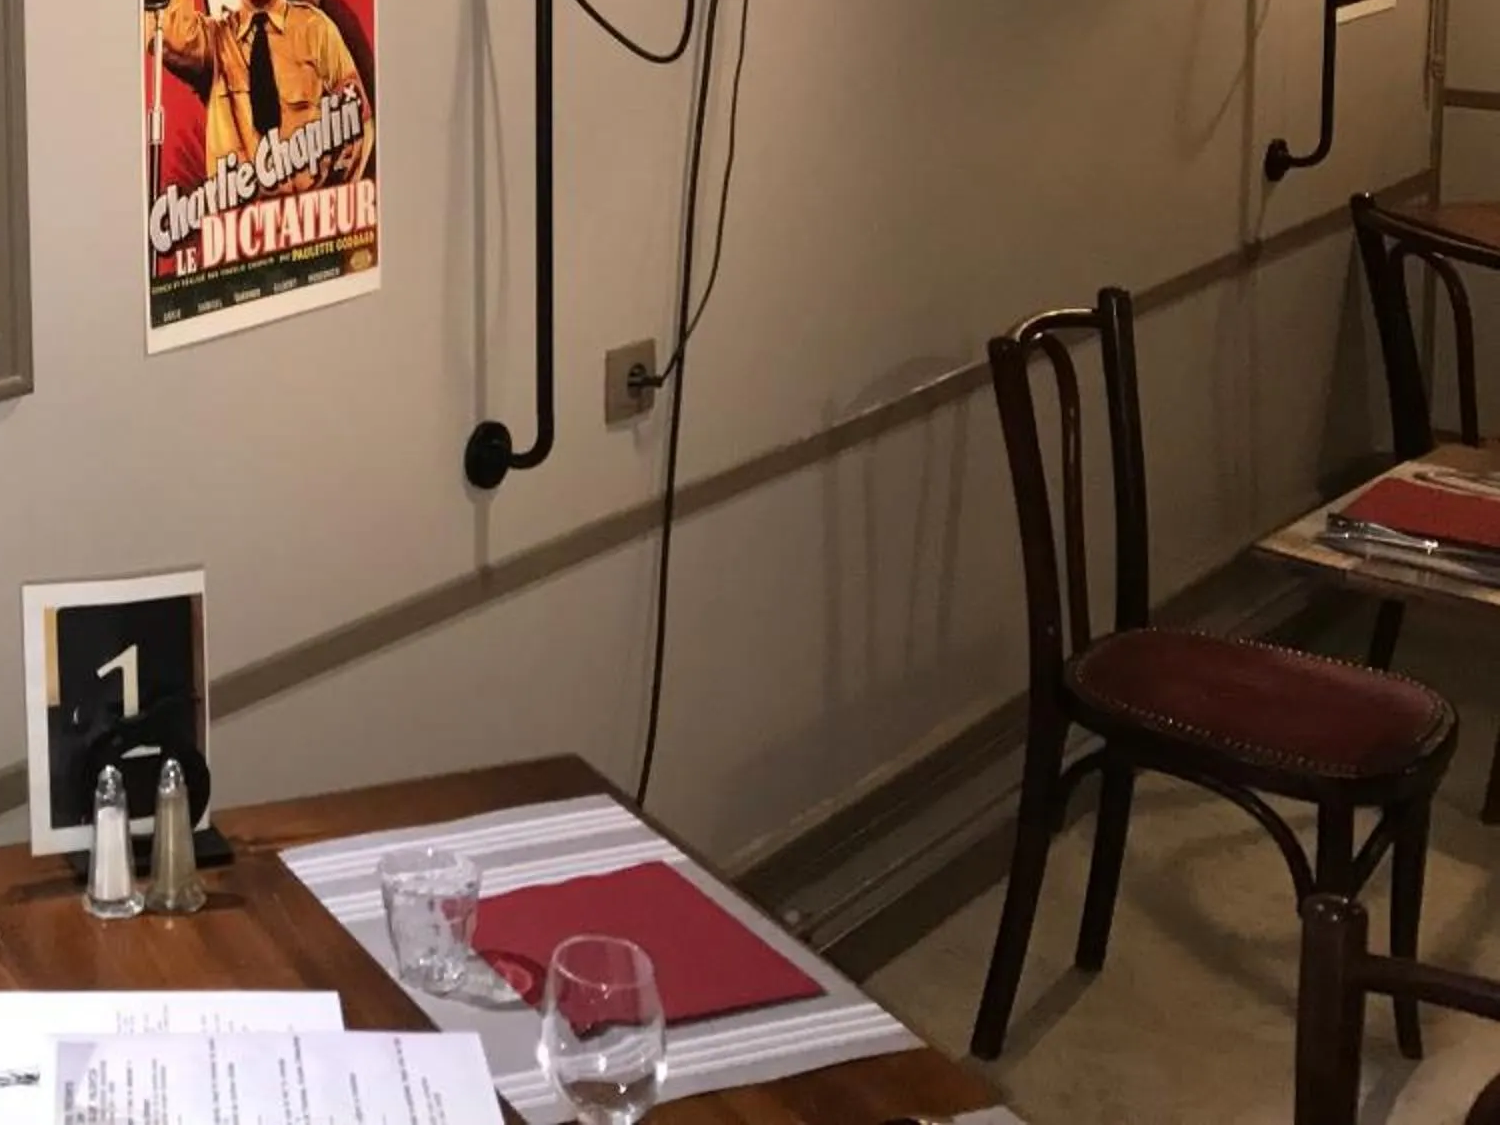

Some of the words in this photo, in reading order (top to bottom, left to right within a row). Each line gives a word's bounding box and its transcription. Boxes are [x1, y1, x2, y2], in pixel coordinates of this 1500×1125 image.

[150, 152, 255, 252] Charlie
[255, 93, 361, 187] Chaplin
[176, 247, 197, 277] LE
[201, 178, 377, 268] DICTATEUR
[97, 644, 139, 718] 1
